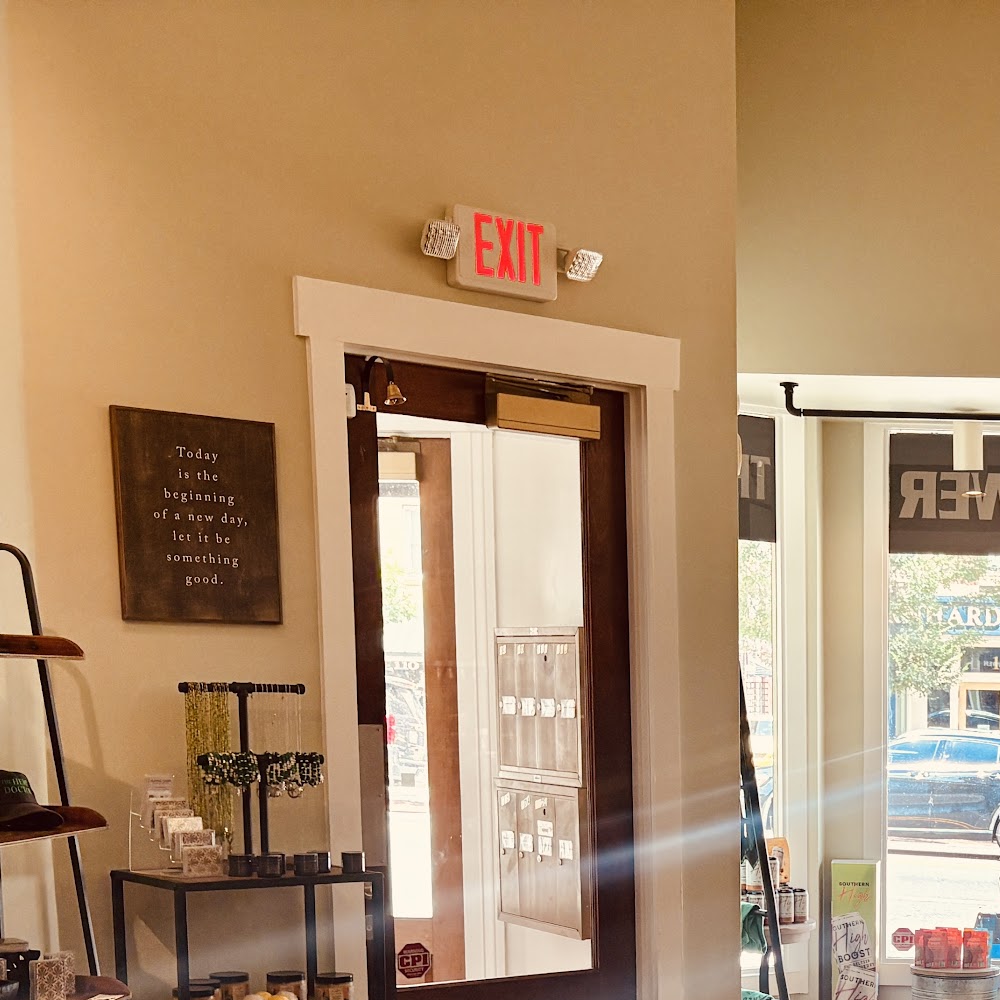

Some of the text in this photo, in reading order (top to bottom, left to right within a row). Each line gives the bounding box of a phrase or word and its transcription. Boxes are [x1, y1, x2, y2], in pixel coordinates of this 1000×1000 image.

[473, 212, 544, 286] EXIT
[176, 446, 219, 463] Today
[178, 468, 218, 482] is the
[164, 488, 235, 506] beginning
[153, 509, 168, 520] of
[188, 513, 214, 522] new
[221, 512, 248, 527] day,
[173, 531, 231, 544] let it be
[167, 553, 239, 568] something
[185, 574, 224, 586] good.
[832, 919, 865, 931] OUTHERN
[399, 953, 429, 967] CPI
[838, 948, 871, 963] BOOST
